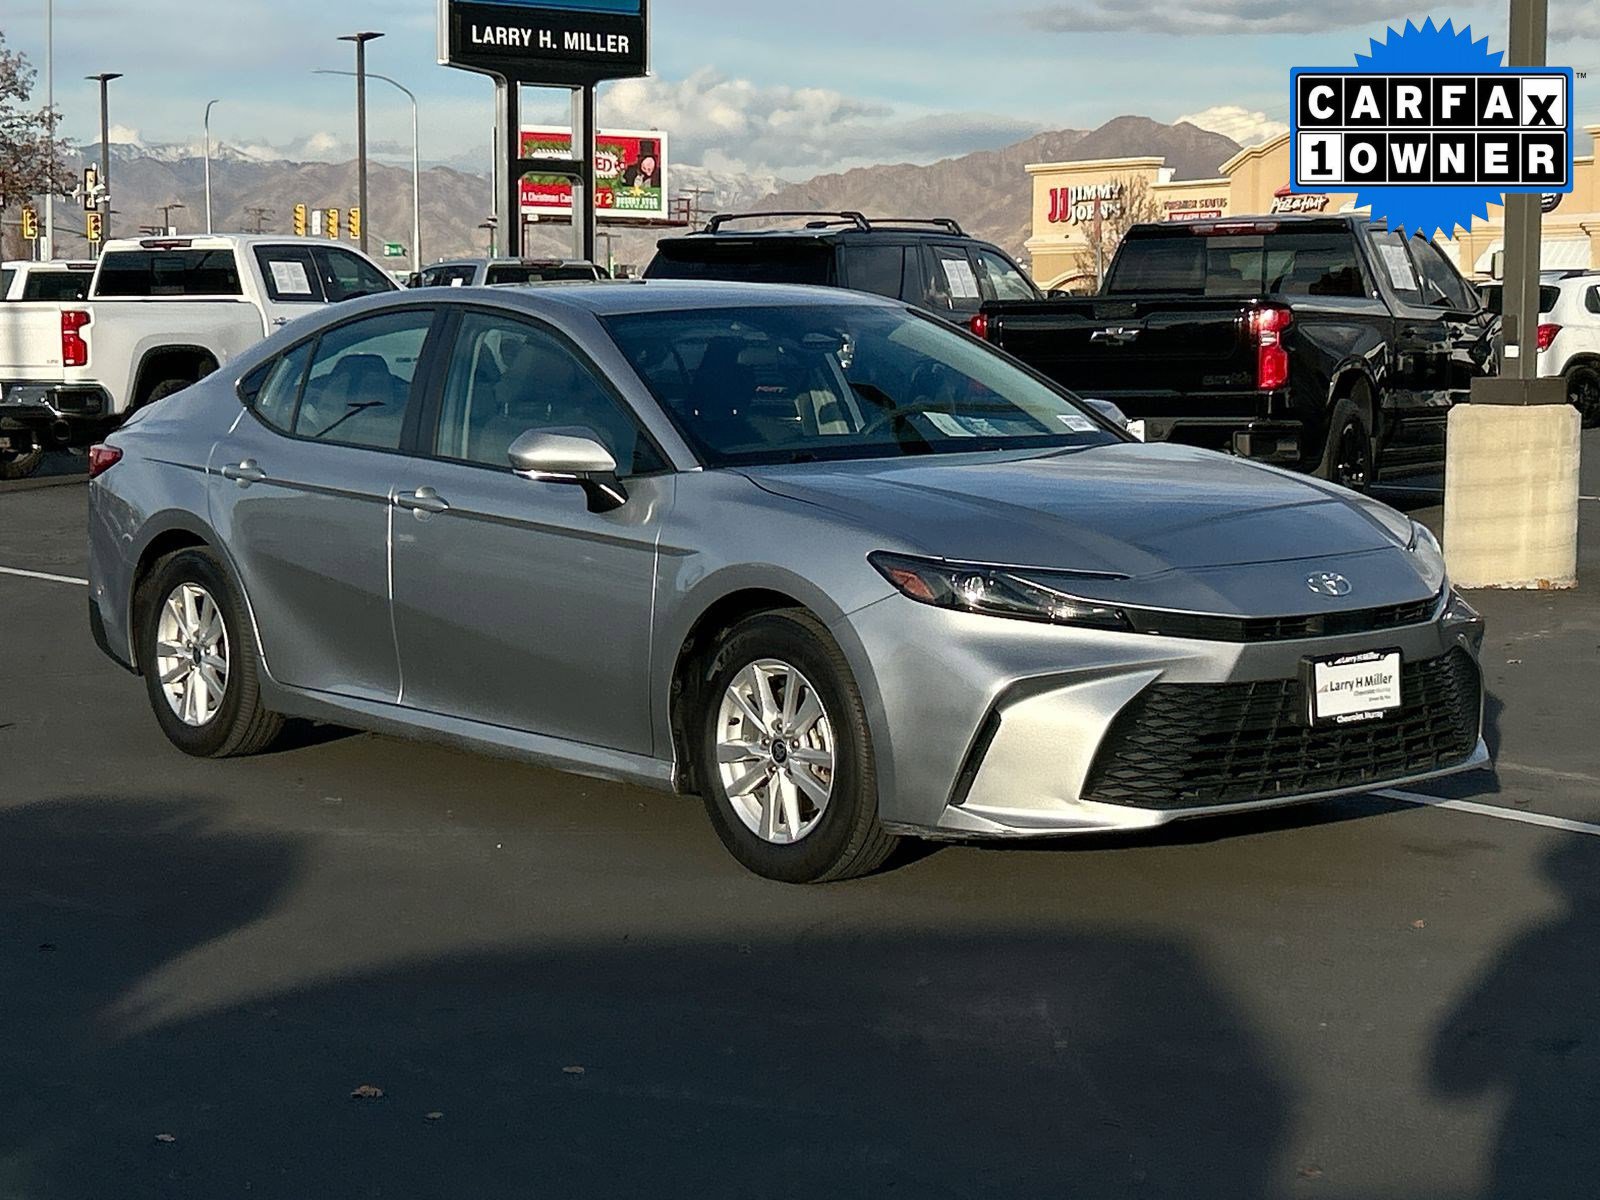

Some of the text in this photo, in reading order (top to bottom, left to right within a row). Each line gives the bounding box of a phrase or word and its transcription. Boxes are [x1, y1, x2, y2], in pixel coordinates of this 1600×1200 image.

[471, 24, 630, 54] LARRY H. MILLER
[1070, 183, 1121, 205] JIMMY
[1330, 672, 1393, 692] Larry H Miller
